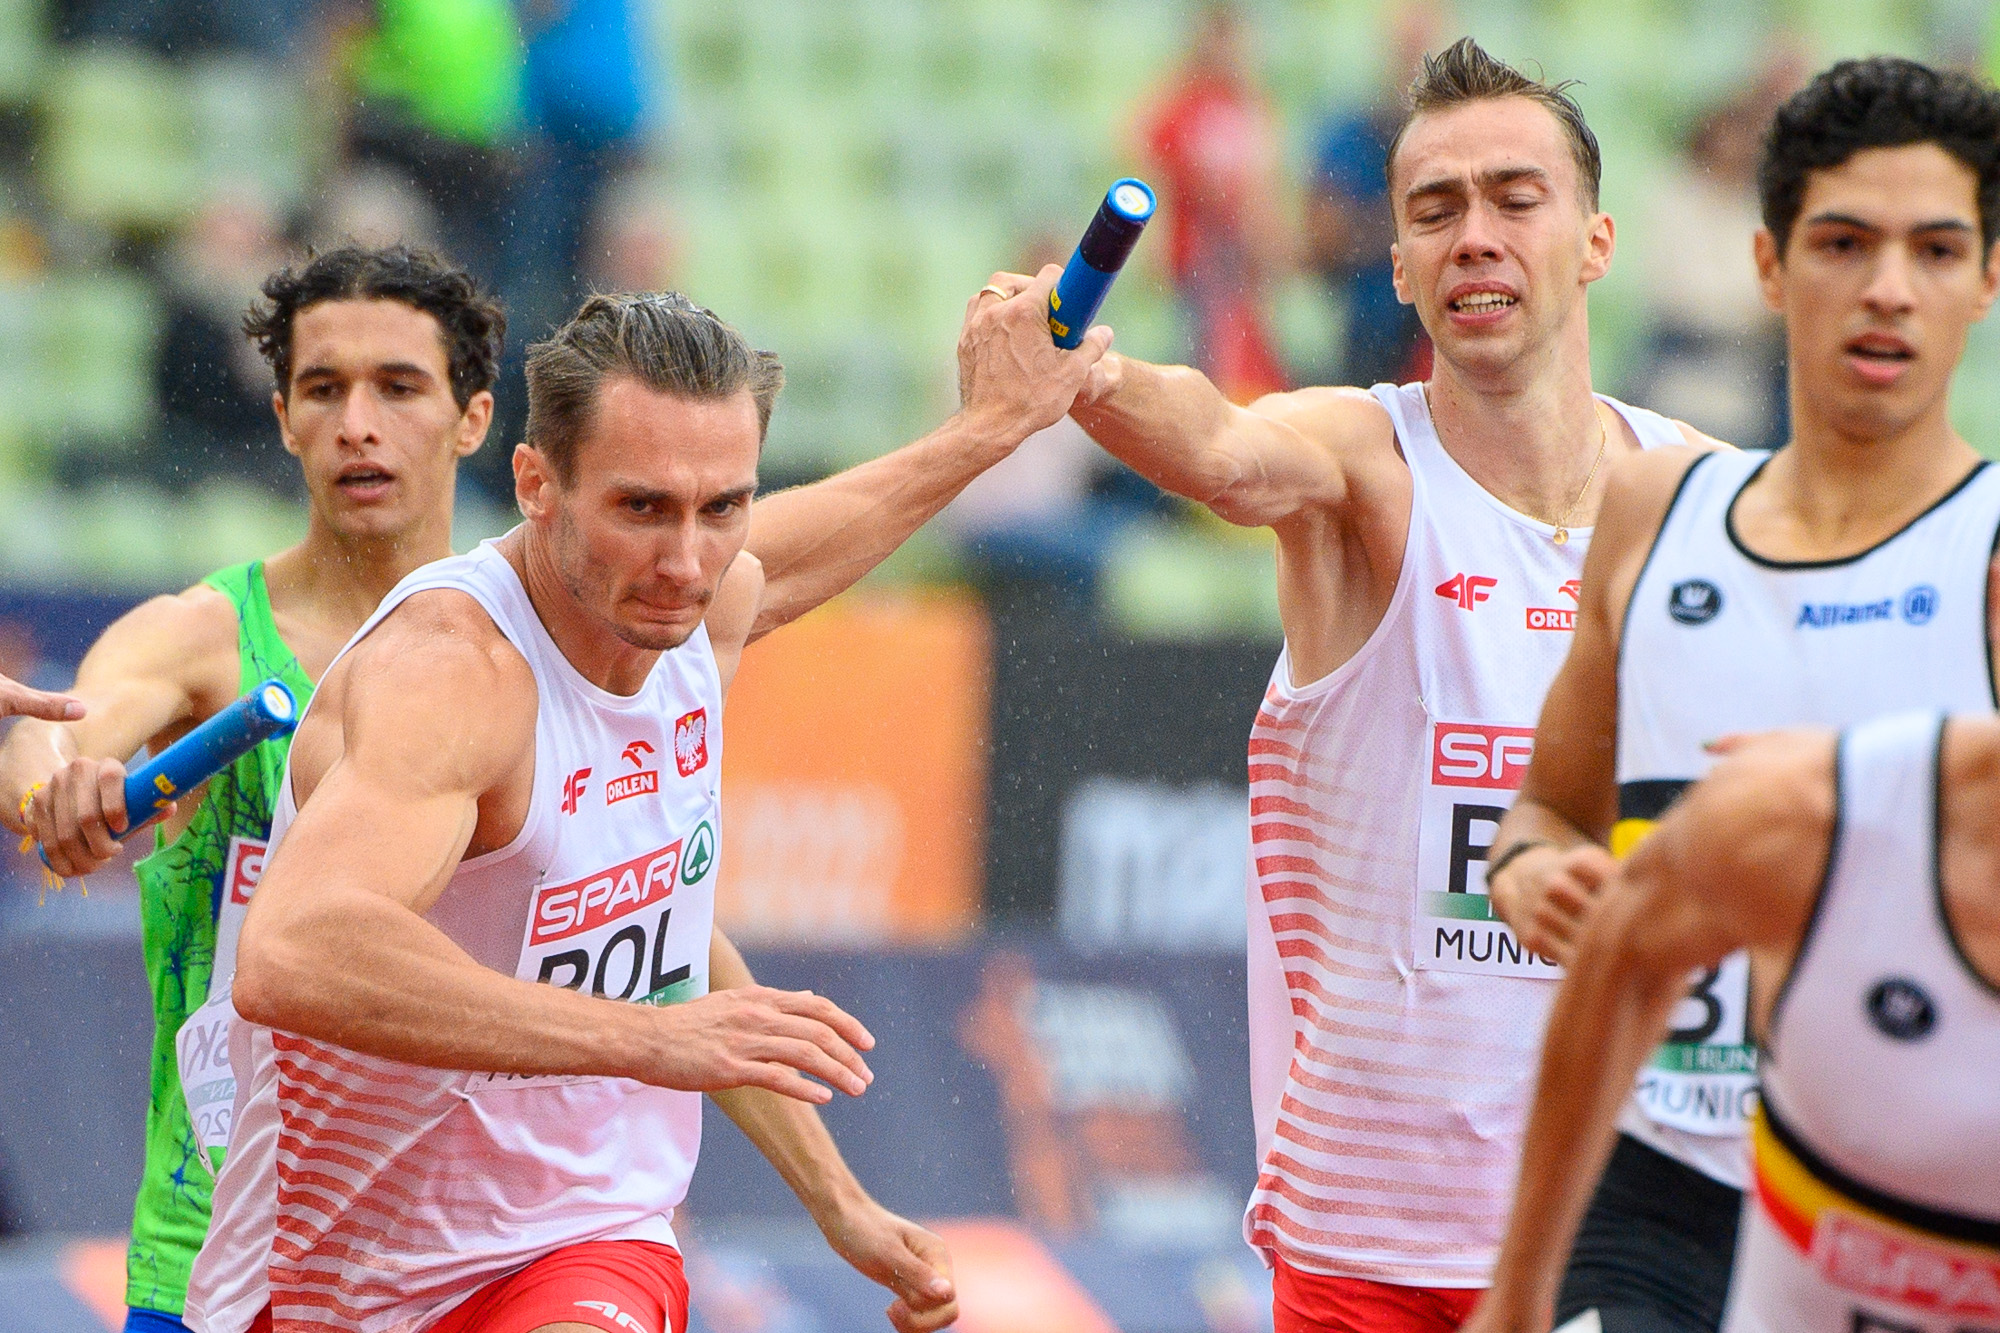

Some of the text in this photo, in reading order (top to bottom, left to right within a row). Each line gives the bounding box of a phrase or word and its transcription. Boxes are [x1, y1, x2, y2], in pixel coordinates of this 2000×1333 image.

[1435, 572, 1498, 612] 4F
[1529, 610, 1578, 629] ORL
[1797, 598, 1893, 628] Allianz
[561, 767, 592, 816] 4F
[607, 774, 656, 802] ORLEN
[537, 851, 678, 936] SPAR
[536, 908, 691, 999] POL
